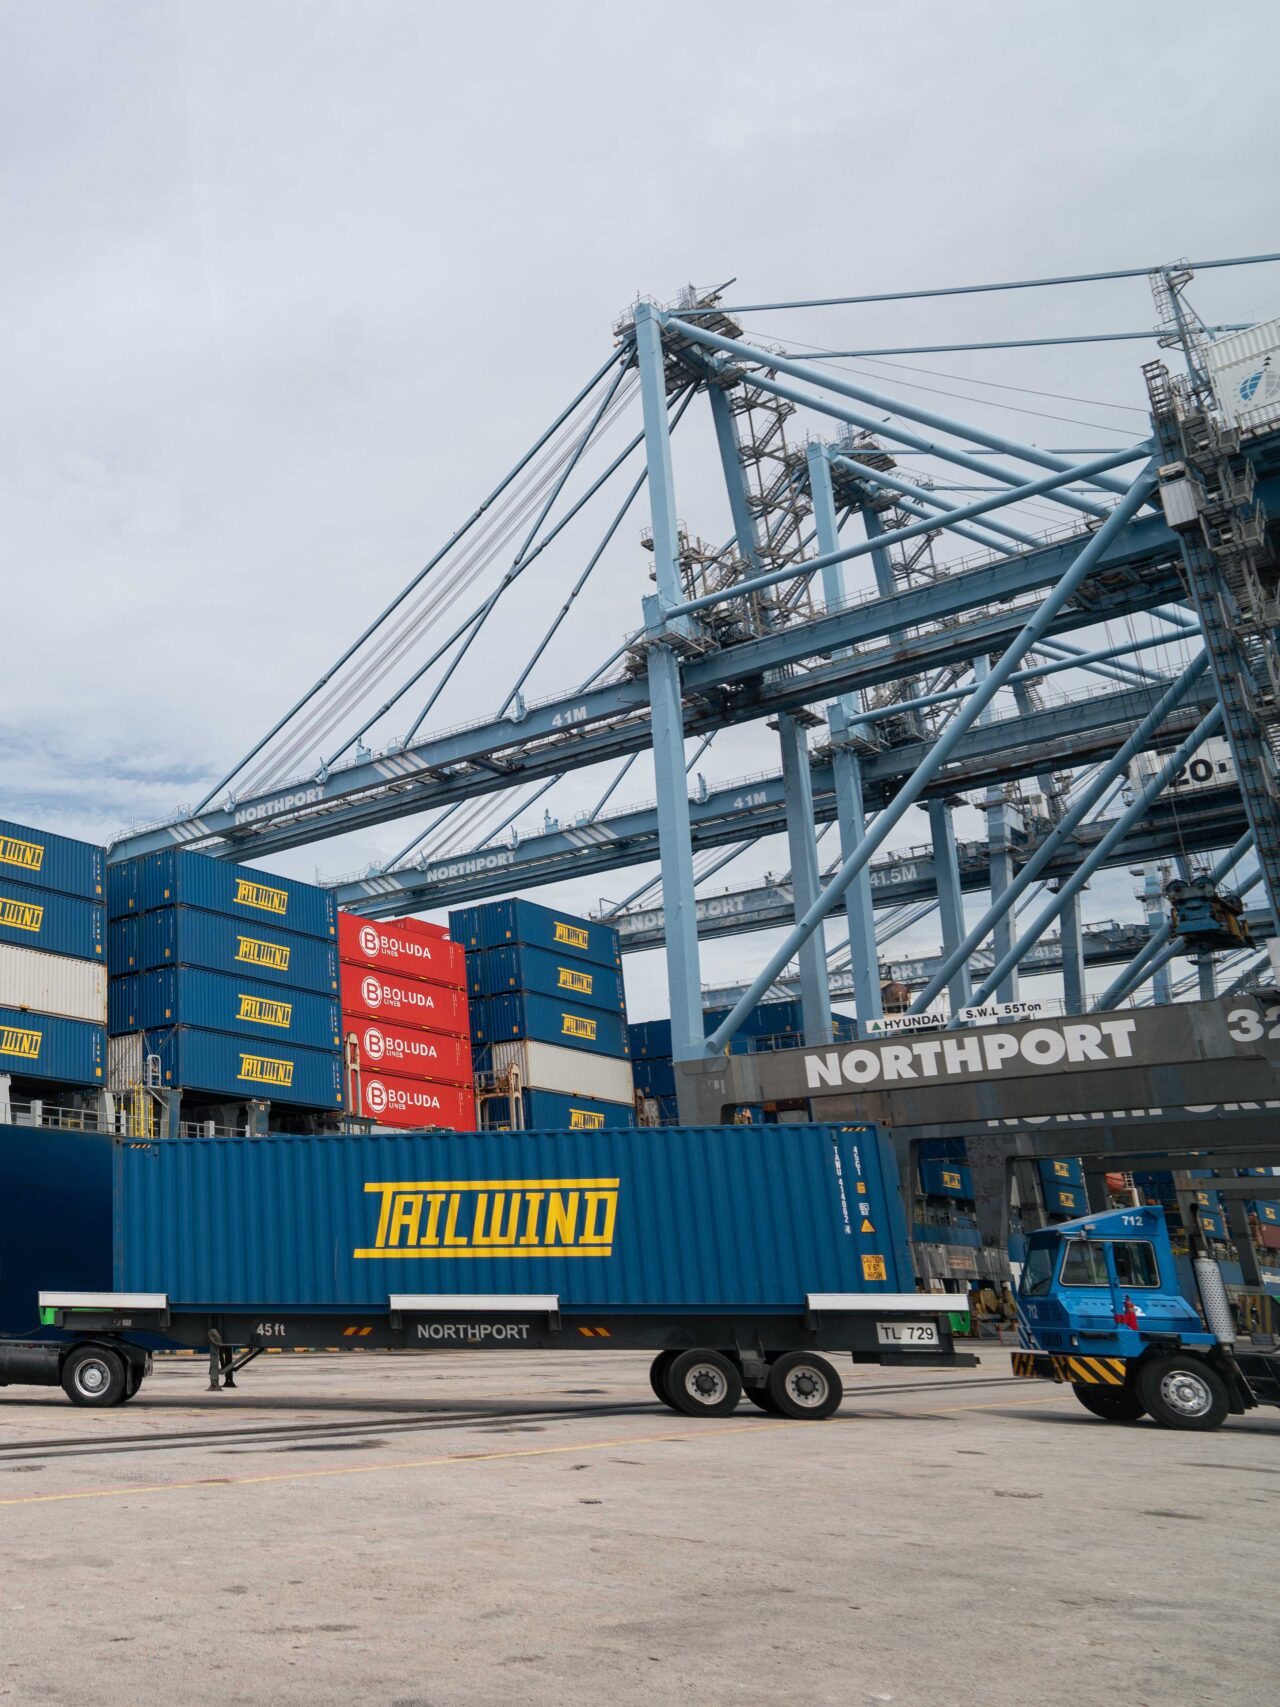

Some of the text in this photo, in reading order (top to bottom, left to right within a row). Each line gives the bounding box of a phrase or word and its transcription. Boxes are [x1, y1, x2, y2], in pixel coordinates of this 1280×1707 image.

[551, 706, 588, 727] 41M
[234, 785, 326, 825] NORTHPORT
[732, 790, 767, 809] 41M
[426, 850, 516, 882] NORTHPORT
[870, 864, 917, 887] 41.5M
[233, 878, 289, 915] TAILWIND
[631, 895, 745, 931] NOPORT
[235, 935, 291, 971] TAILWIND
[380, 936, 432, 959] BOLUDA
[381, 948, 399, 957] LINES
[1034, 944, 1063, 958] 41.5
[383, 986, 435, 1008] BOLUDA
[384, 999, 401, 1008] LINES
[236, 994, 293, 1029] TAILWIND
[966, 1002, 1042, 1019] S.W.L 55Ton
[884, 1013, 945, 1030] HYUNDAI
[386, 1037, 438, 1058] BOLUDA
[386, 1050, 404, 1058] LINES
[804, 1018, 1137, 1089] NORTHPORT
[236, 1053, 294, 1087] TAILWIND
[388, 1089, 440, 1109] BOLUDA
[389, 1102, 407, 1110] LINES
[353, 1178, 622, 1259] TAILWIND
[1122, 1215, 1144, 1226] 712
[867, 1271, 883, 1280] HIGH
[256, 1323, 286, 1336] 45 ft
[417, 1324, 530, 1339] NORTHPORT
[881, 1326, 934, 1340] TL 729
